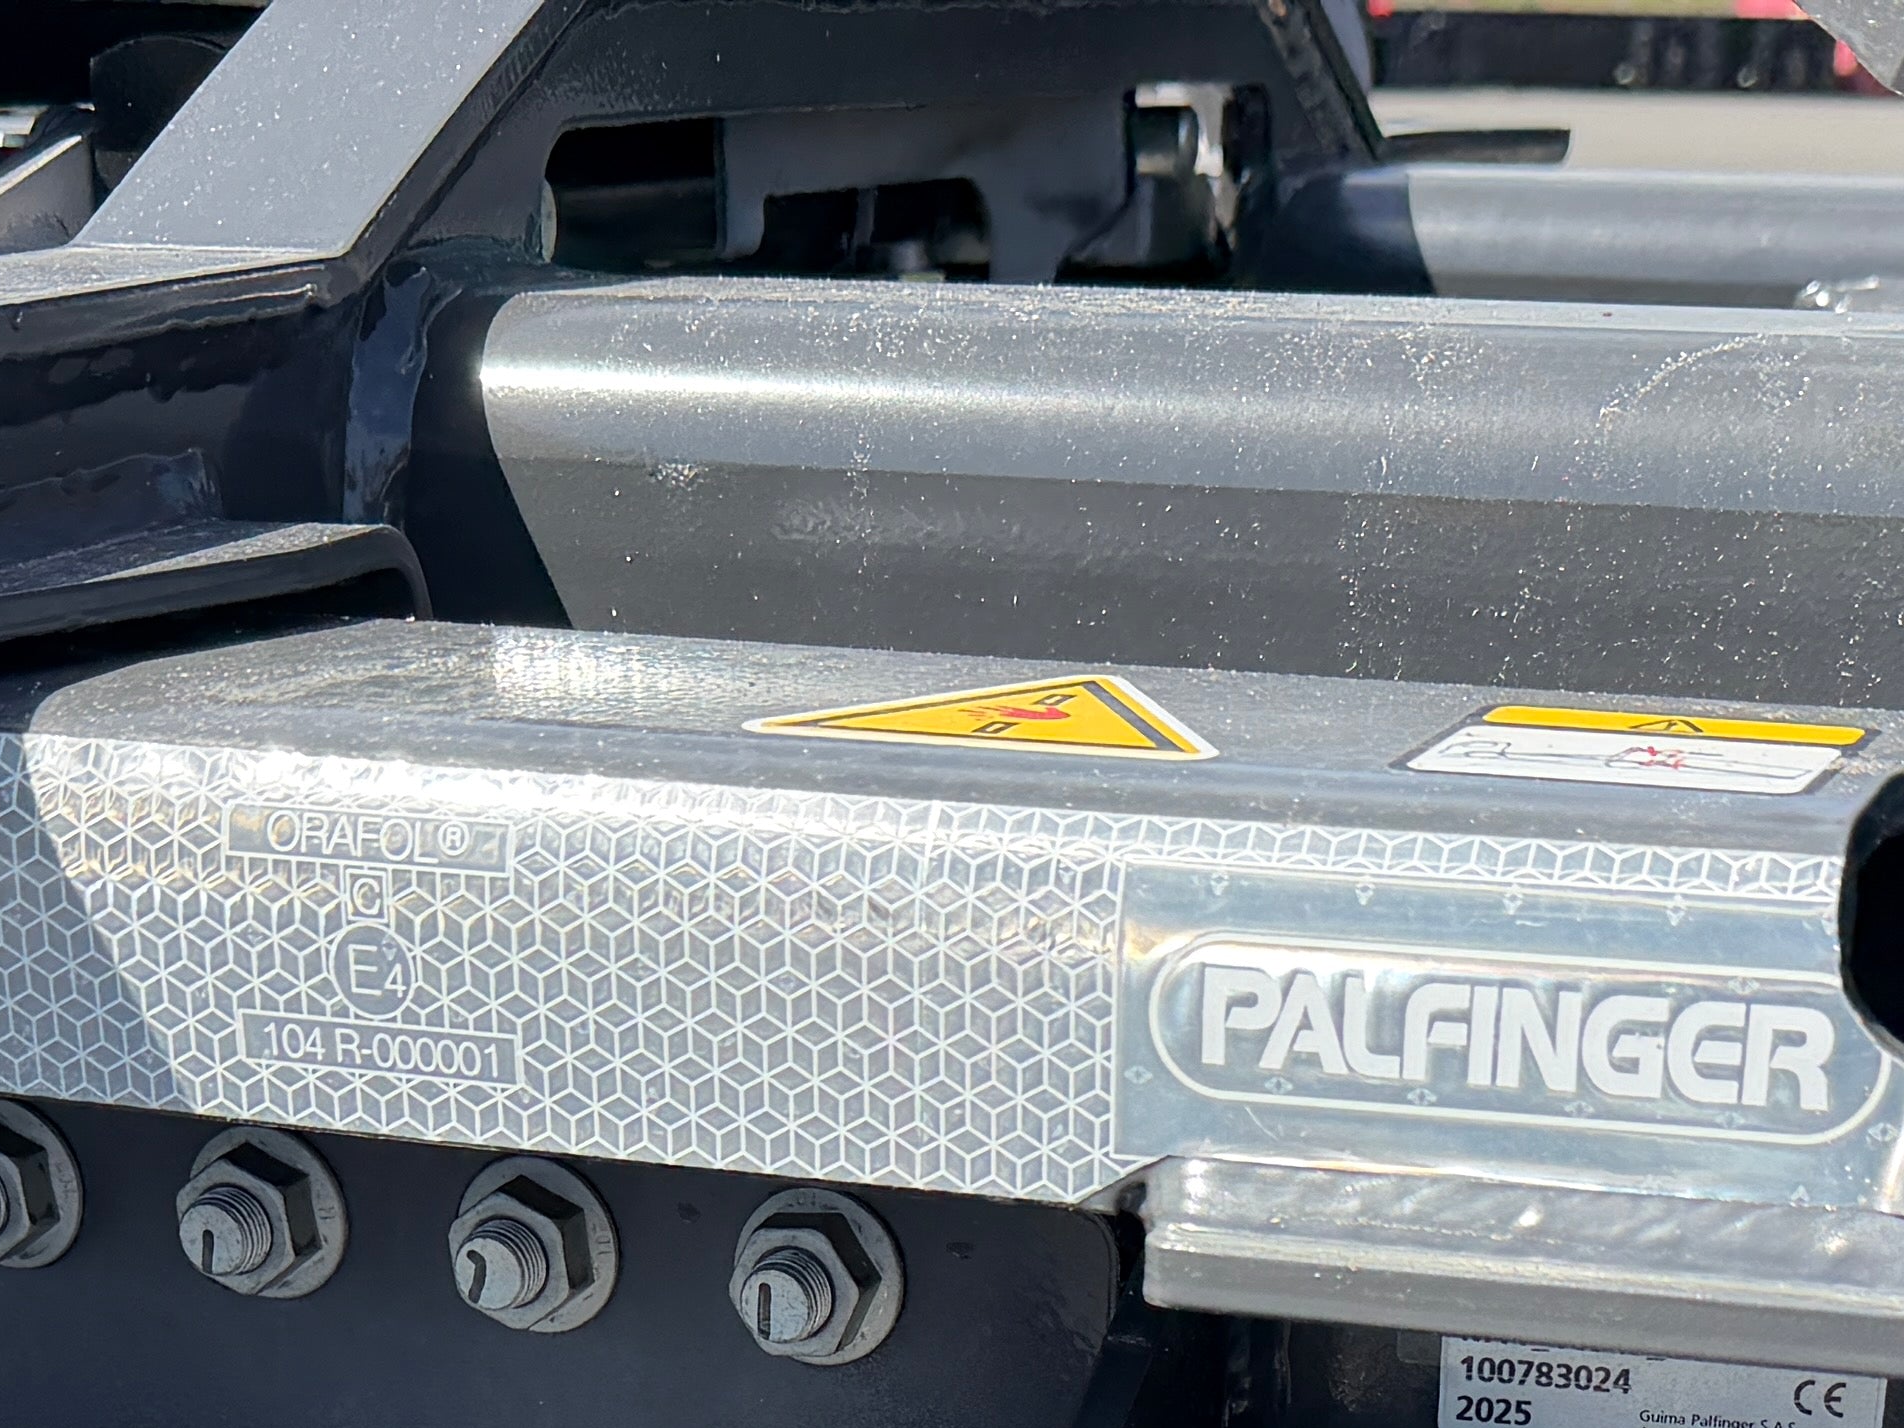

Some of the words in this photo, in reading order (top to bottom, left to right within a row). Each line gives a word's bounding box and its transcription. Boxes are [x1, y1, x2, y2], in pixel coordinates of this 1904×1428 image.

[351, 876, 382, 915] C
[263, 1022, 327, 1062] 104
[335, 1027, 499, 1078] R-000001
[1201, 964, 1830, 1113] PALFINGER
[1459, 1355, 1633, 1394] 100783024
[1454, 1394, 1534, 1426] 2025
[1638, 1408, 1687, 1427] Guima
[1793, 1378, 1847, 1418] CE
